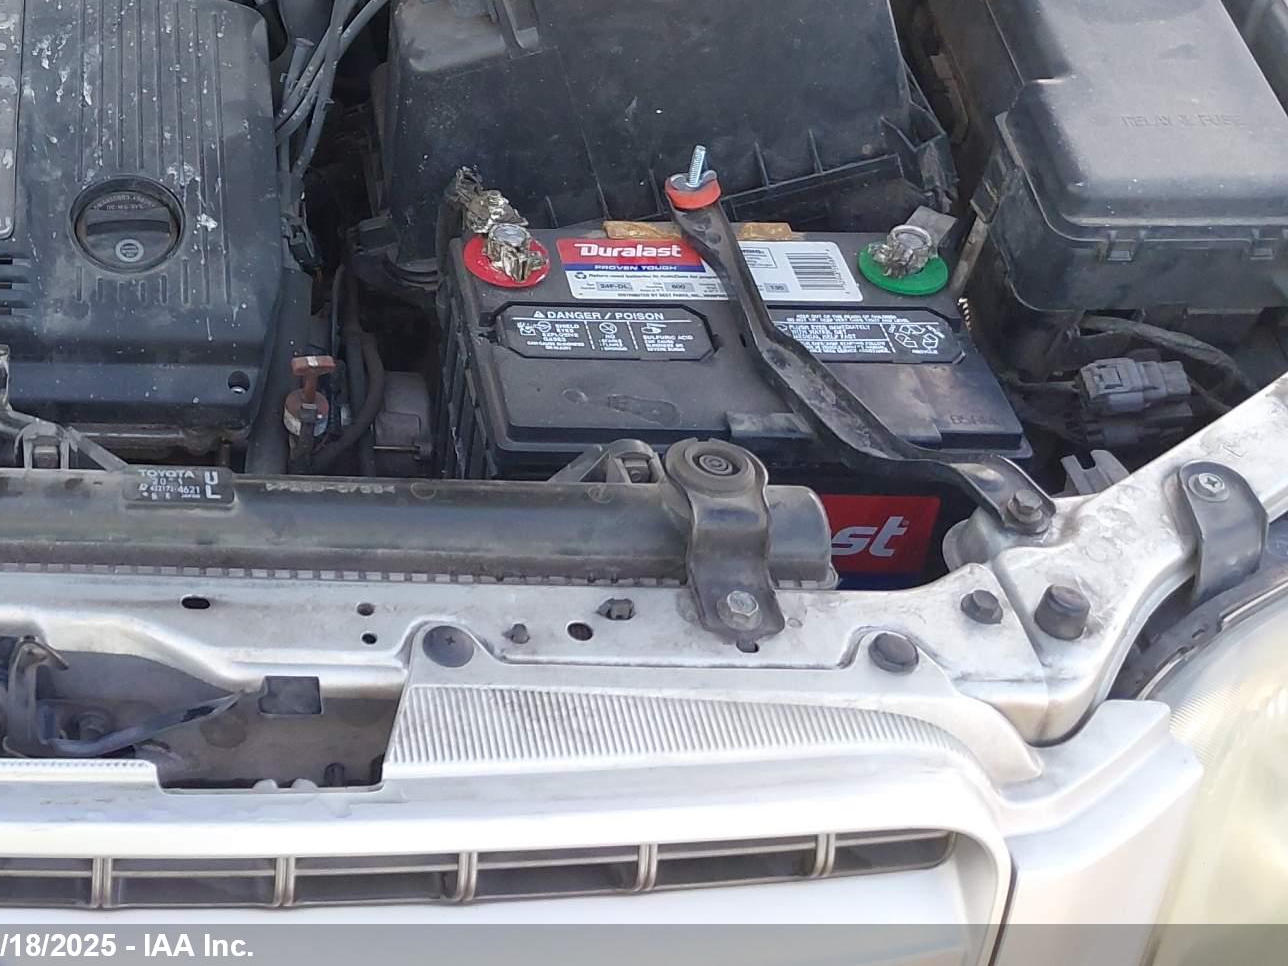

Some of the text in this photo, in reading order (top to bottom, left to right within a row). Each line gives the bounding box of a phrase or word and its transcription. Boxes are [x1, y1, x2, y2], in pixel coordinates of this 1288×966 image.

[574, 243, 682, 257] Duralast
[546, 312, 602, 320] DANGER
[616, 312, 665, 320] POISON
[138, 469, 218, 485] TOYOTA U
[206, 485, 221, 499] L
